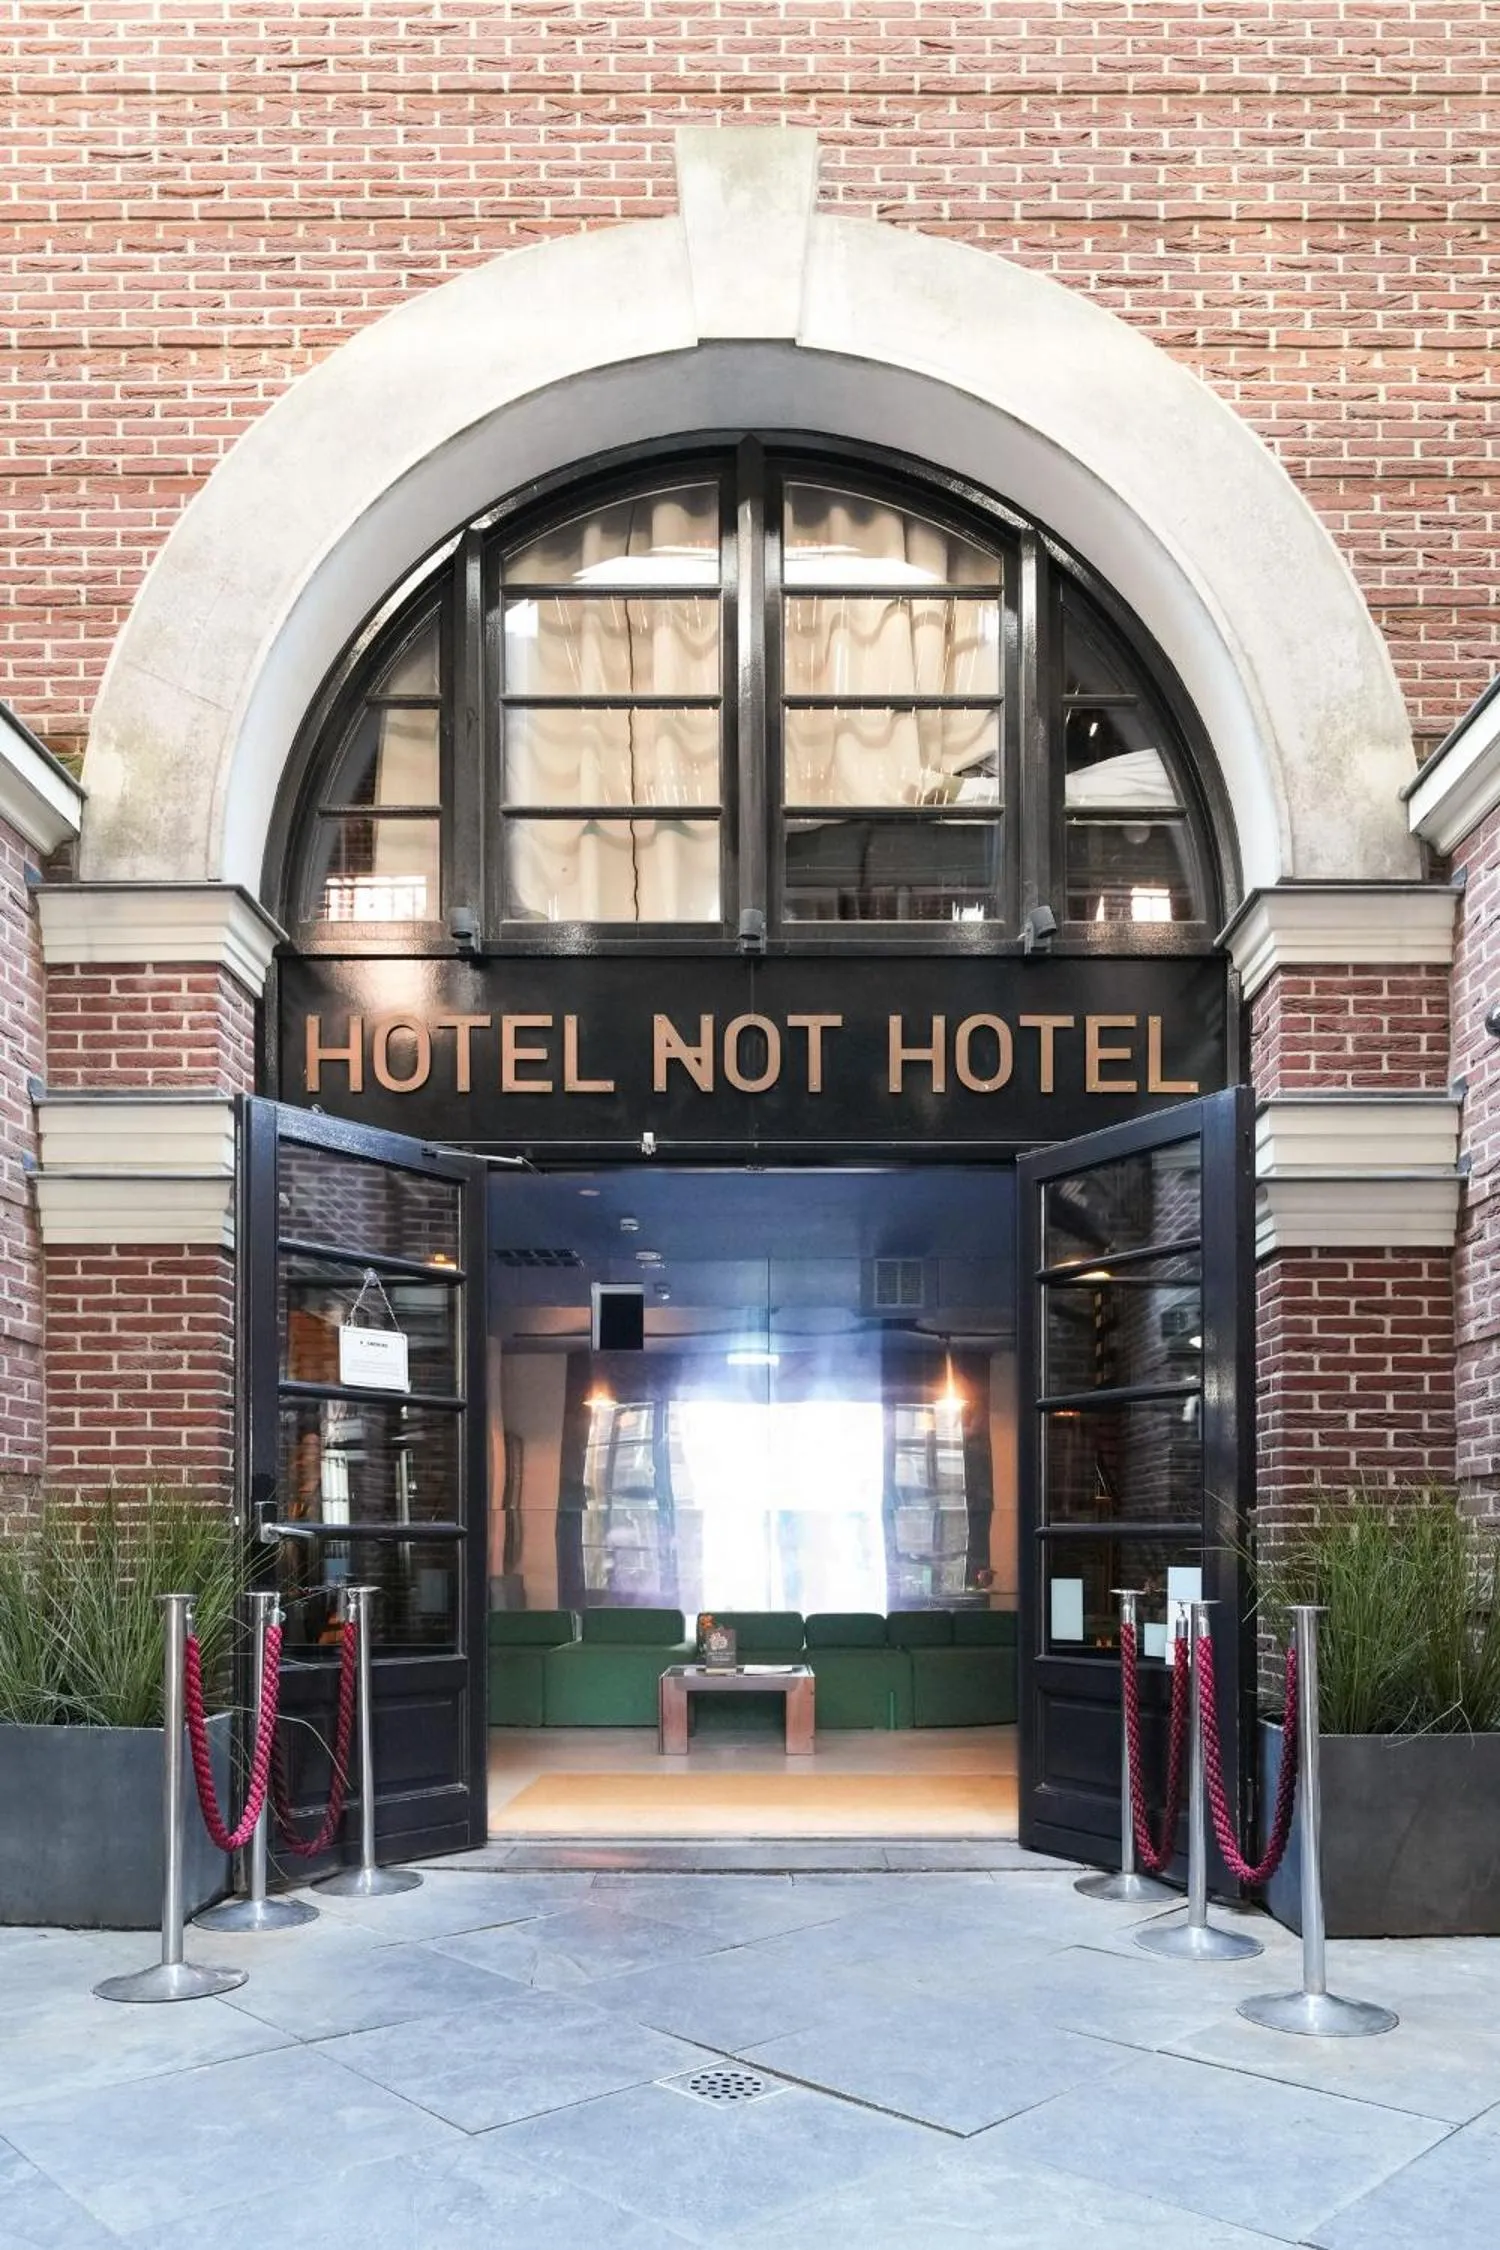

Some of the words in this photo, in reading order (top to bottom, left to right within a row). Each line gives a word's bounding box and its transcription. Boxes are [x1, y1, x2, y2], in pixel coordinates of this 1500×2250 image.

[305, 1014, 615, 1093] HOTEL
[653, 1014, 843, 1093] NOT
[888, 1013, 1199, 1093] HOTEL
